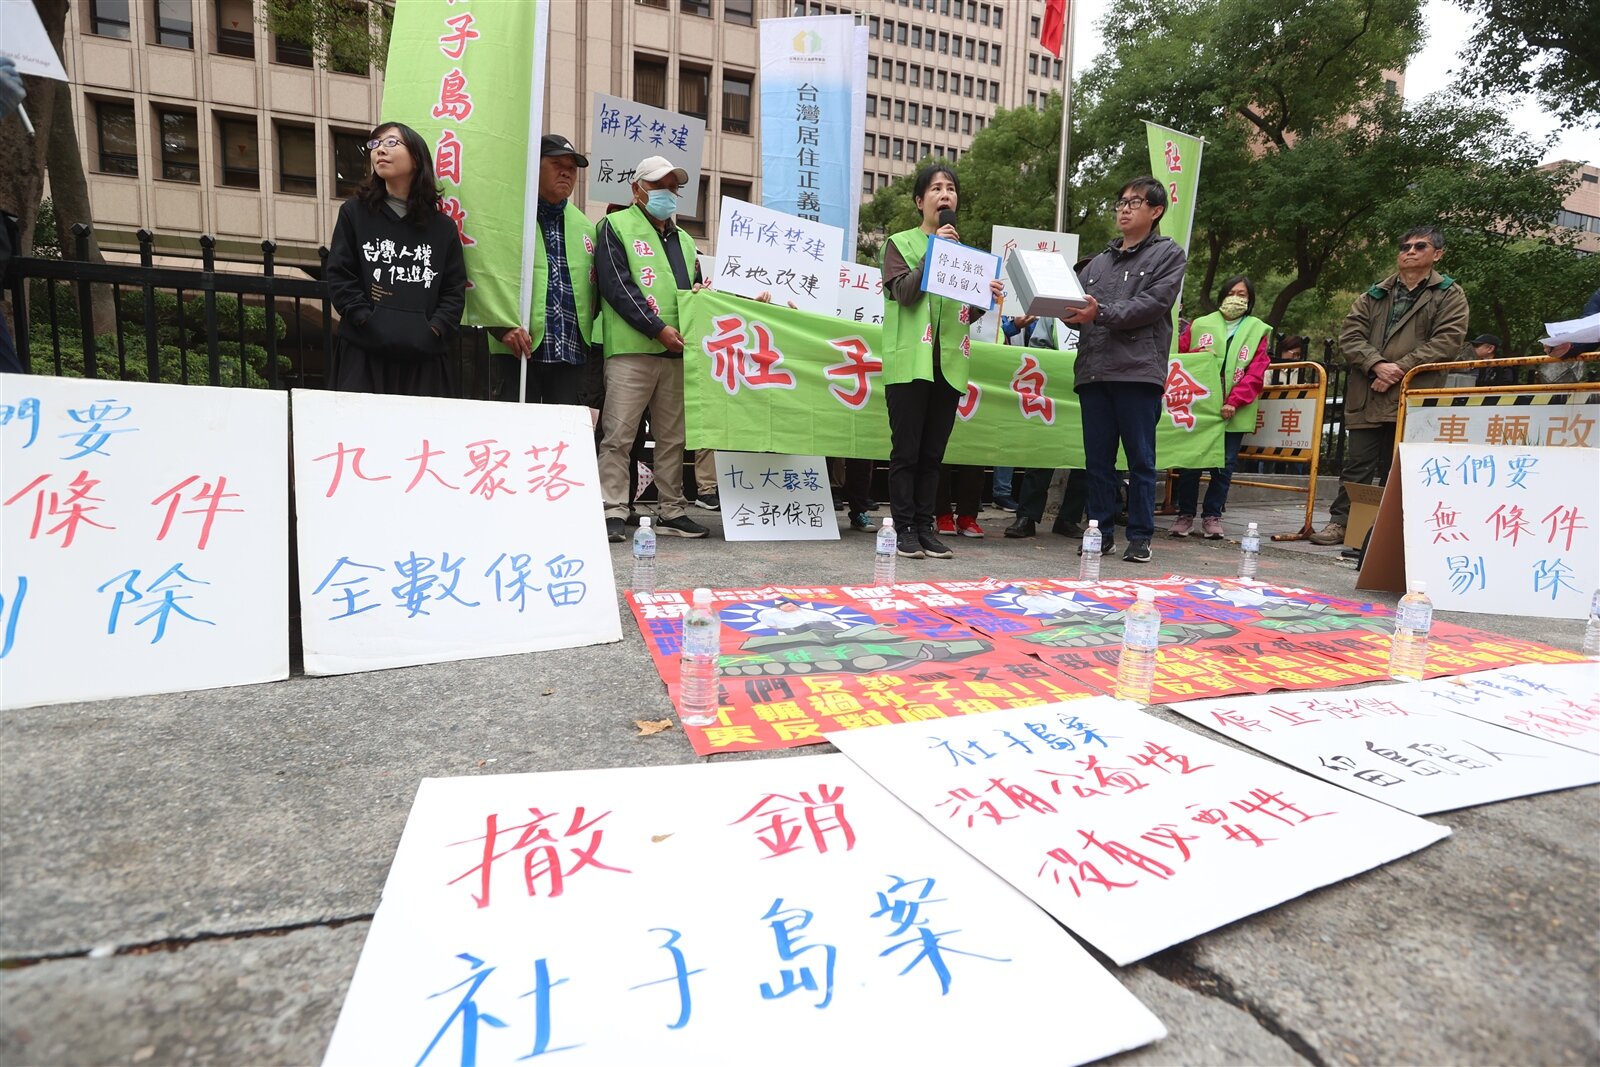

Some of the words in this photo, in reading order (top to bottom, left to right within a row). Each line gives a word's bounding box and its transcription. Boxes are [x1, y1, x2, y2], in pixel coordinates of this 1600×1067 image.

[600, 103, 689, 152] 解除禁建
[730, 210, 826, 262] 解除禁建
[388, 265, 438, 289] 促進會
[721, 255, 820, 299] 原地改建
[936, 270, 981, 294] 留島留人
[1434, 414, 1597, 446] 車輛改
[312, 439, 585, 501] 九大聚落
[724, 464, 823, 492] 九大聚落
[1418, 454, 1540, 489] 我們要
[731, 501, 824, 528] 全部保留
[1424, 501, 1590, 551] 無條件
[312, 551, 586, 621] 全數保留
[1446, 555, 1585, 600] 剔除
[927, 713, 1124, 767] 社子島案
[446, 783, 856, 909] 撤銷
[414, 874, 1012, 1067] 社子島案
